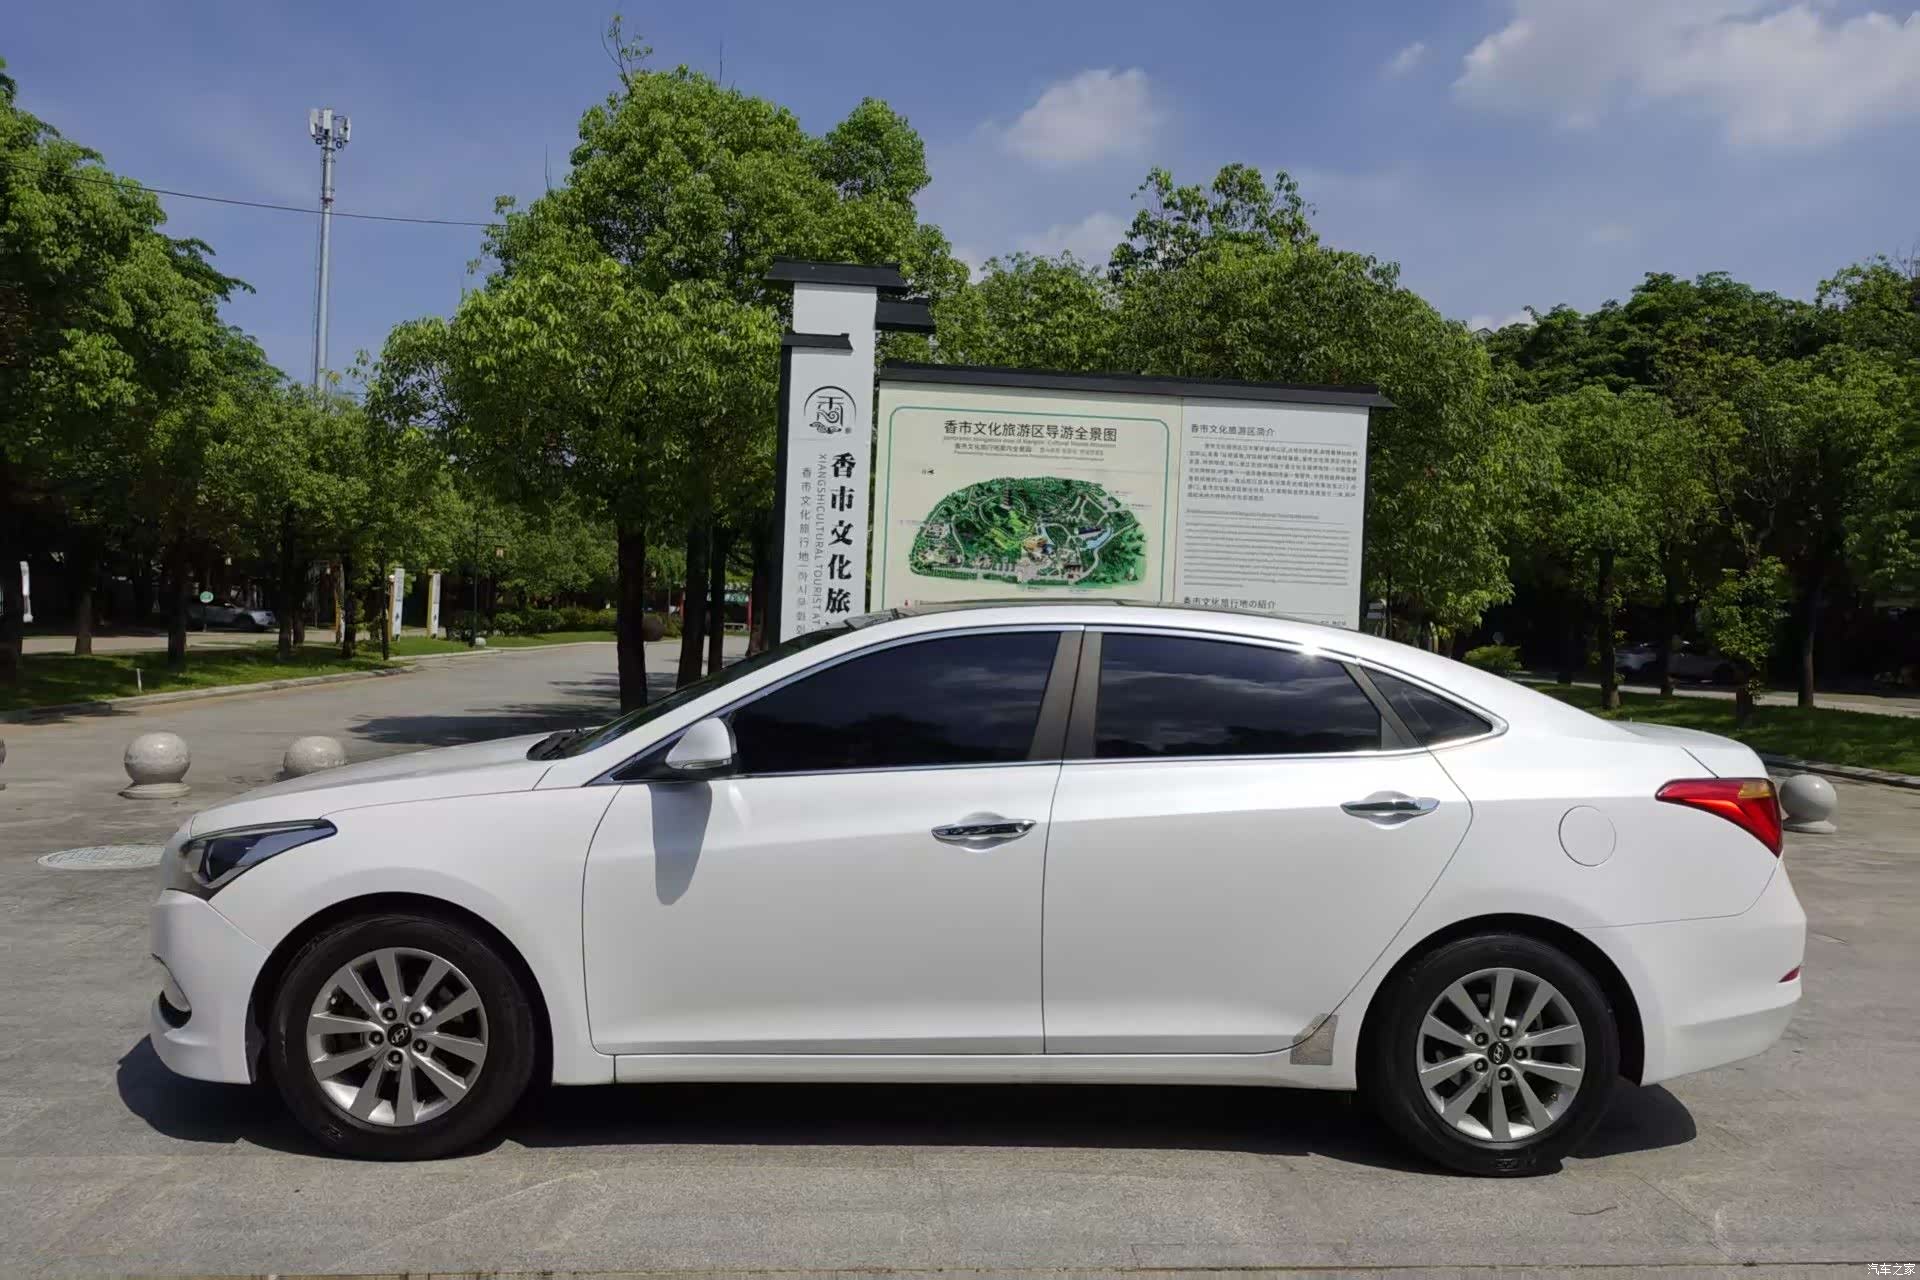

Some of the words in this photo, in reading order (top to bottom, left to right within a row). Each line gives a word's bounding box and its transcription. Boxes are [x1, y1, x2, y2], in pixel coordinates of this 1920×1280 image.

[944, 419, 1117, 442] 香市文化旅游区导游全景图
[814, 453, 827, 560] XIANGSHICULTURAL
[825, 452, 856, 625] 香市文化旅
[812, 564, 823, 609] TOURIST
